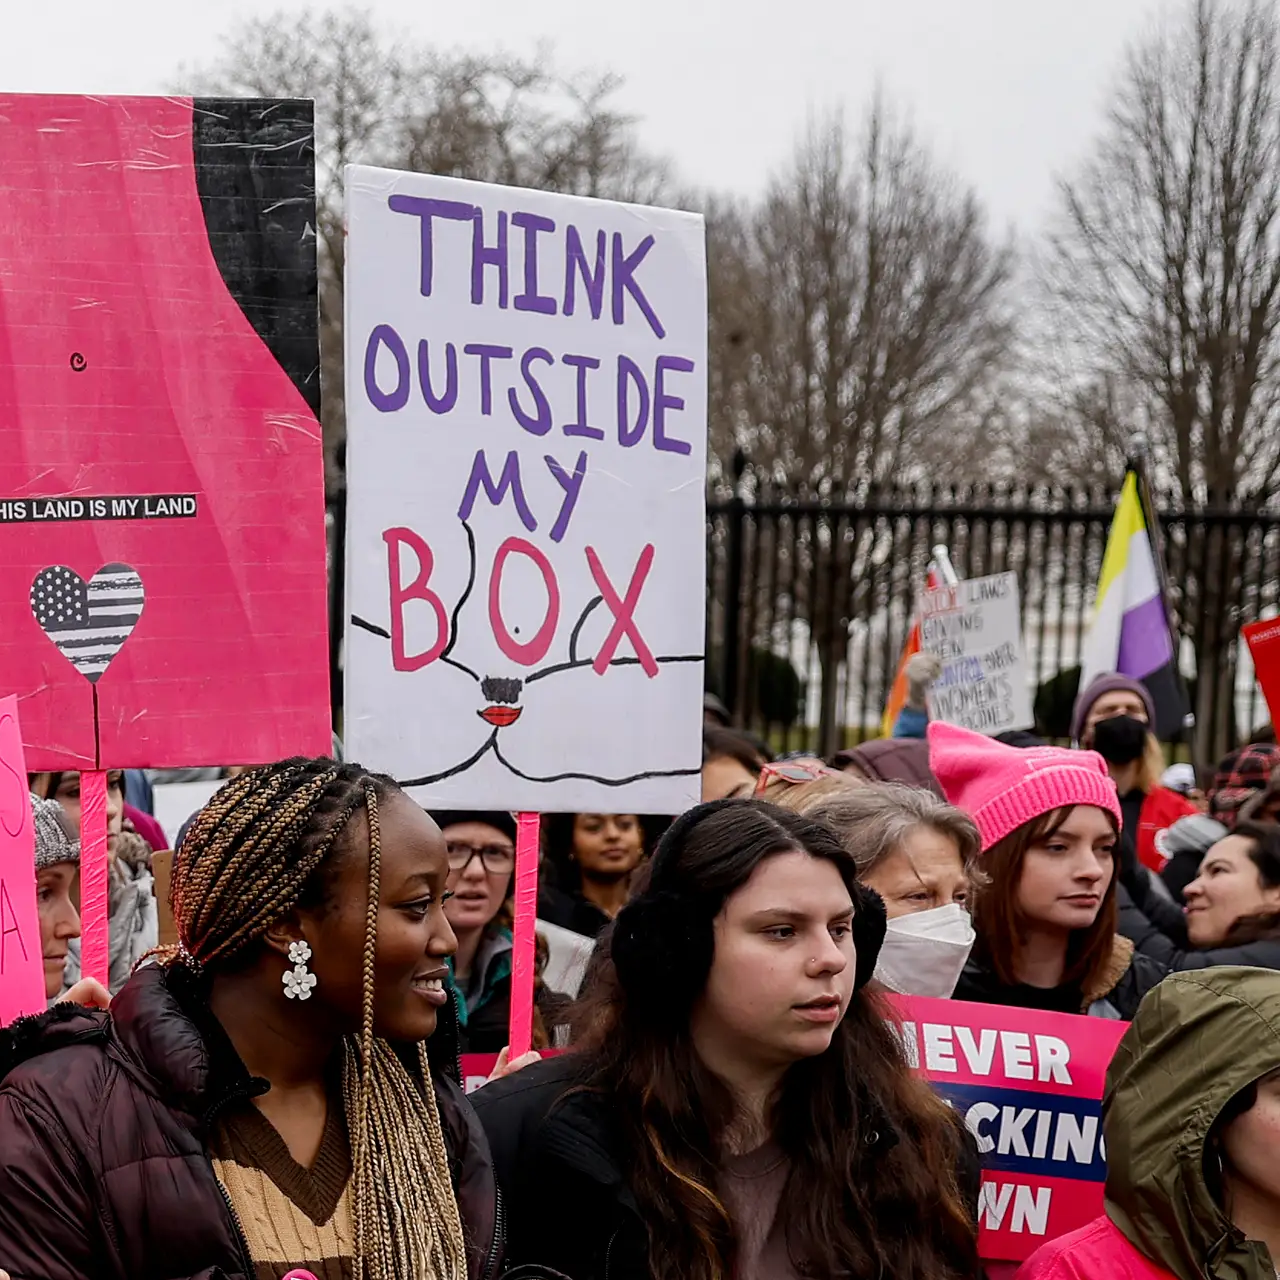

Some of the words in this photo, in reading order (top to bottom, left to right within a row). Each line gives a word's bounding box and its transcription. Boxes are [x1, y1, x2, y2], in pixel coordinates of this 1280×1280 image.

[387, 195, 666, 339] THINK
[364, 324, 694, 455] OUTSIDE
[32, 501, 84, 519] LAND
[90, 500, 106, 517] IS
[112, 499, 139, 516] MY
[144, 498, 196, 516] LAND
[458, 449, 587, 543] MY
[382, 526, 659, 679] BOX
[0, 878, 28, 975] A
[964, 1101, 1107, 1165] CKIN
[978, 1181, 1052, 1236] WN
